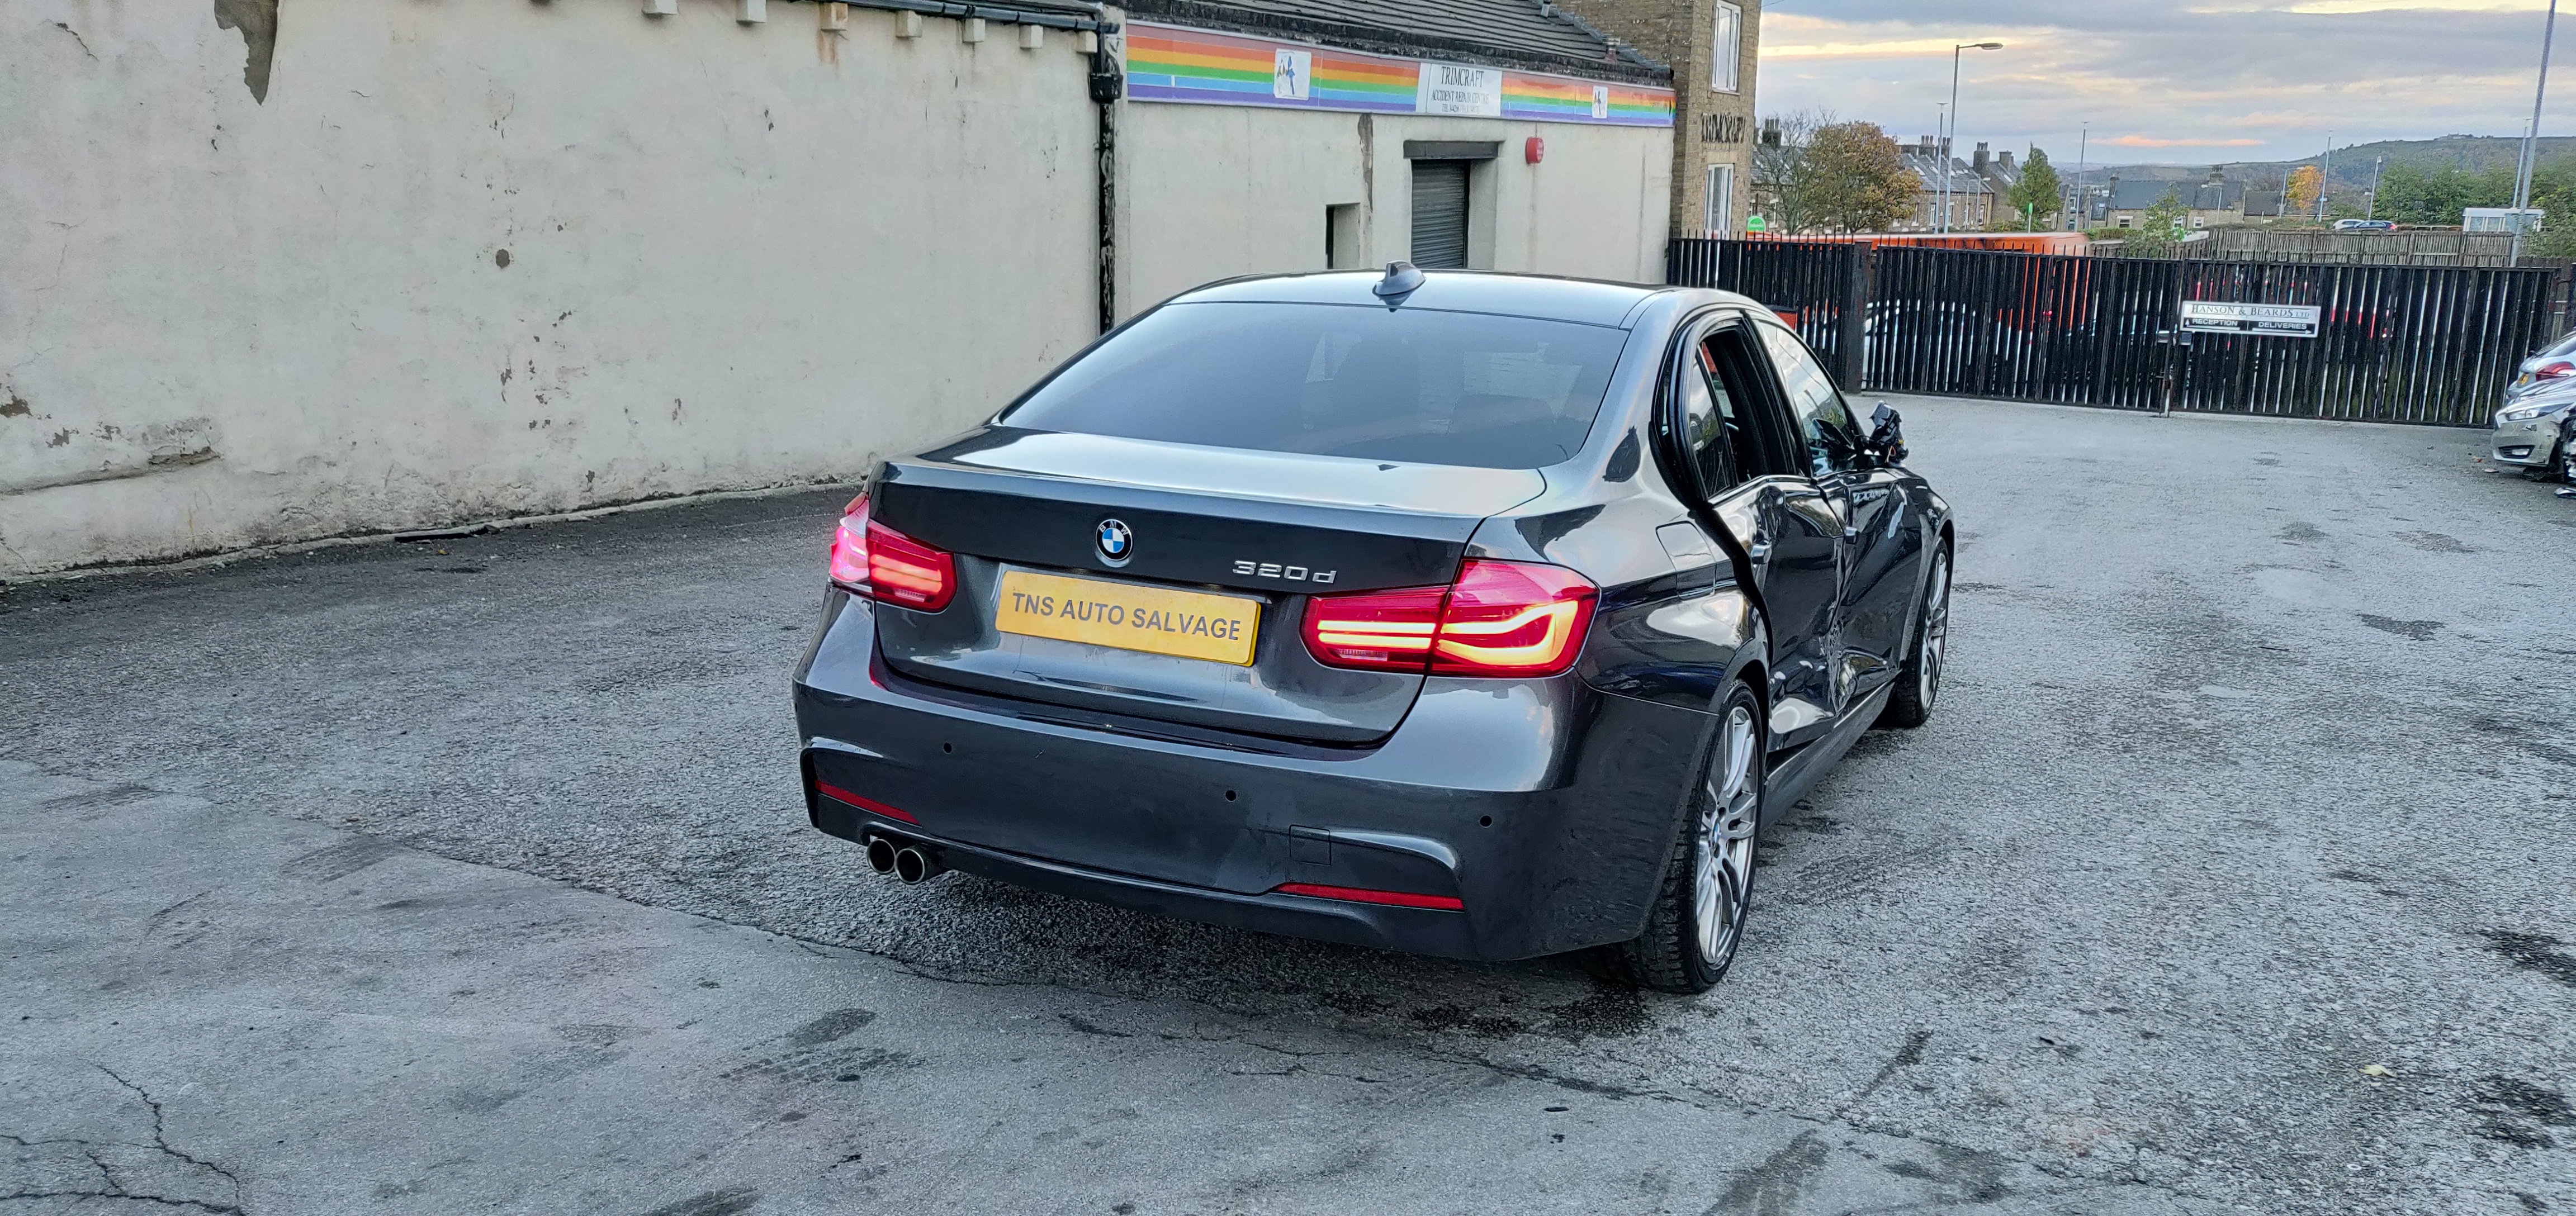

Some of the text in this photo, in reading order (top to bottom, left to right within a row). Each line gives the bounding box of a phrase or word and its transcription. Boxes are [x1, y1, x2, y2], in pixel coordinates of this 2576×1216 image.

[1441, 66, 1484, 88] TRIMCRAFT
[1432, 89, 1455, 102] ACCIDENT
[1455, 91, 1471, 103] REPAIR
[2191, 304, 2235, 315] HANSON
[2238, 306, 2247, 316] &
[2251, 308, 2293, 317] BEARDS
[1099, 520, 1129, 535] BMW
[1232, 560, 1337, 584] 320d
[1012, 592, 1241, 641] TNS AUTO SALVAGE
